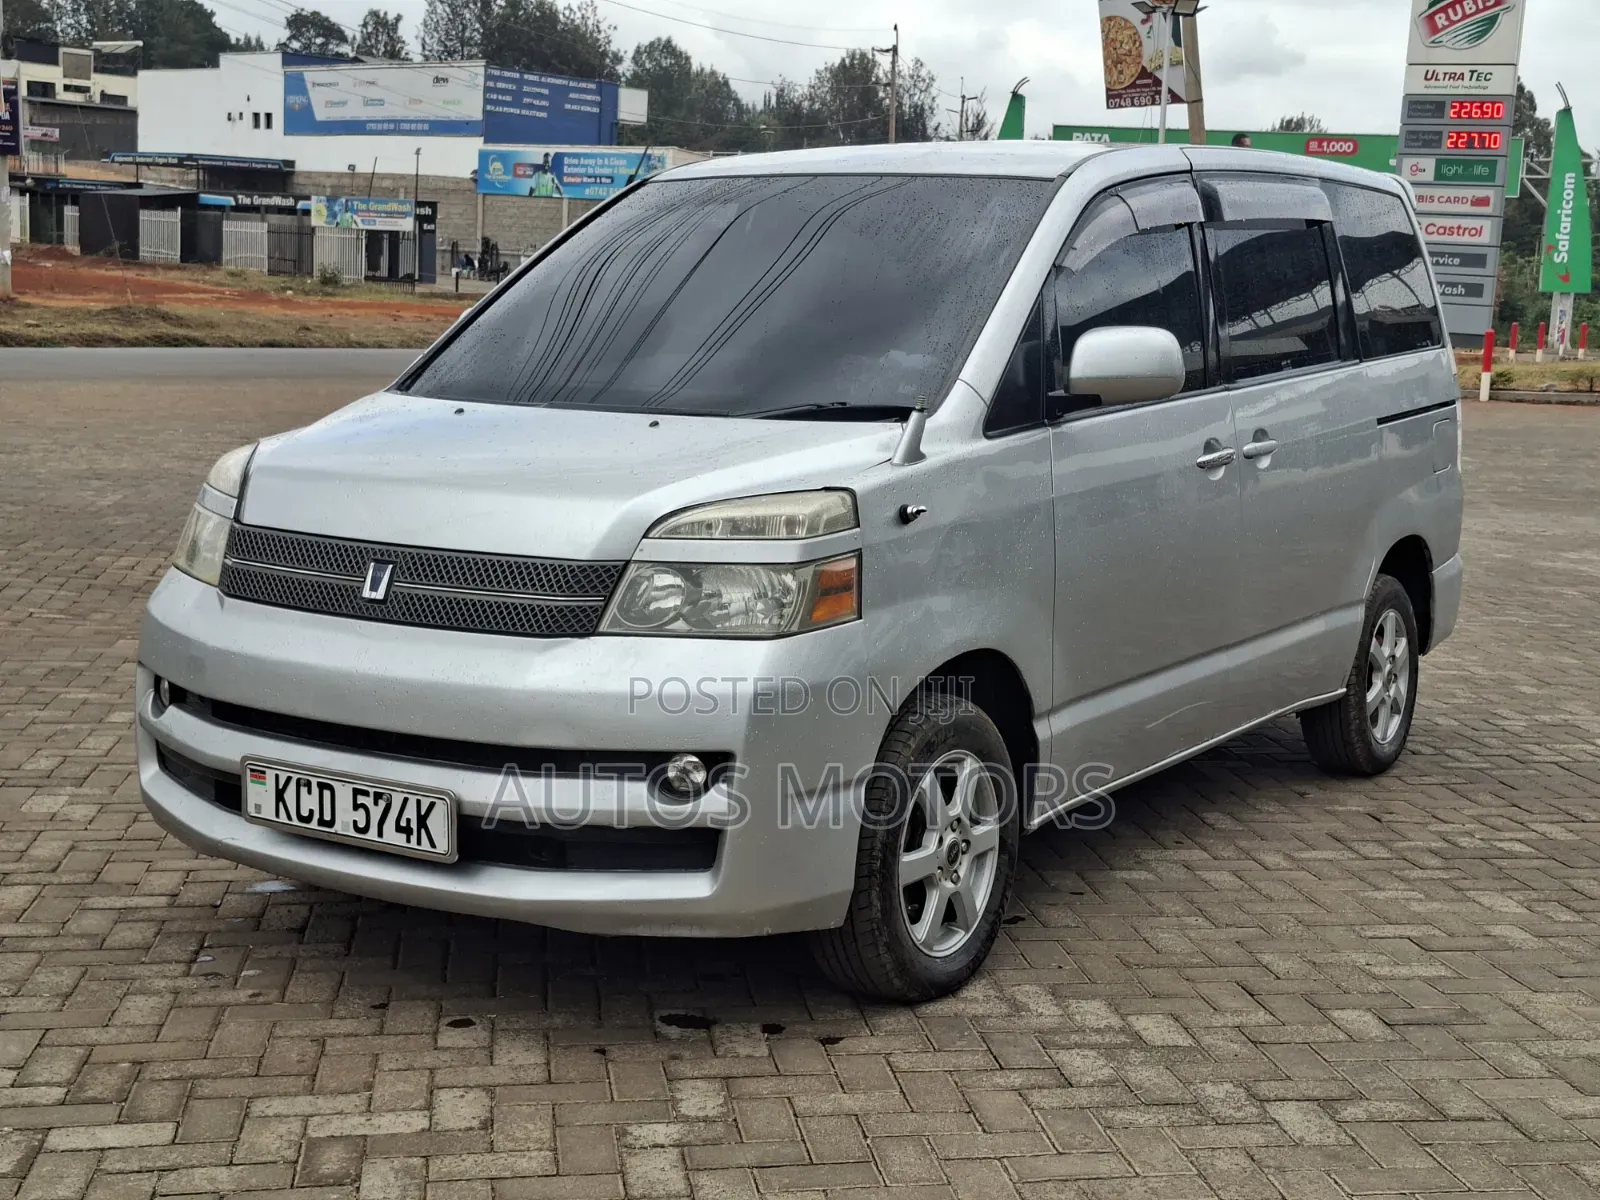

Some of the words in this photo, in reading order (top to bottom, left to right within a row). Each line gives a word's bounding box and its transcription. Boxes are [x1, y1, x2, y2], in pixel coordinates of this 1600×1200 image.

[1434, 0, 1496, 29] RUBIS
[1424, 69, 1465, 82] ULTRA
[1469, 69, 1493, 82] TEC
[1108, 97, 1132, 108] 0748
[1134, 96, 1152, 106] 690
[1154, 94, 1172, 104] 33
[1450, 102, 1503, 118] 226.90
[1072, 132, 1111, 142] PATA
[1447, 132, 1500, 149] 227.70
[1322, 141, 1353, 153] 1,000
[1441, 164, 1464, 176] light
[1474, 165, 1490, 176] life
[237, 195, 251, 205] The
[253, 195, 295, 206] GrandWash
[1415, 194, 1435, 203] BIS
[1437, 196, 1469, 205] CARD
[353, 201, 367, 210] The
[369, 202, 412, 212] GrandWash
[1554, 172, 1576, 263] Safaricom
[1425, 222, 1483, 238] Castrol
[274, 773, 337, 829] KCD
[352, 787, 438, 849] 574K
